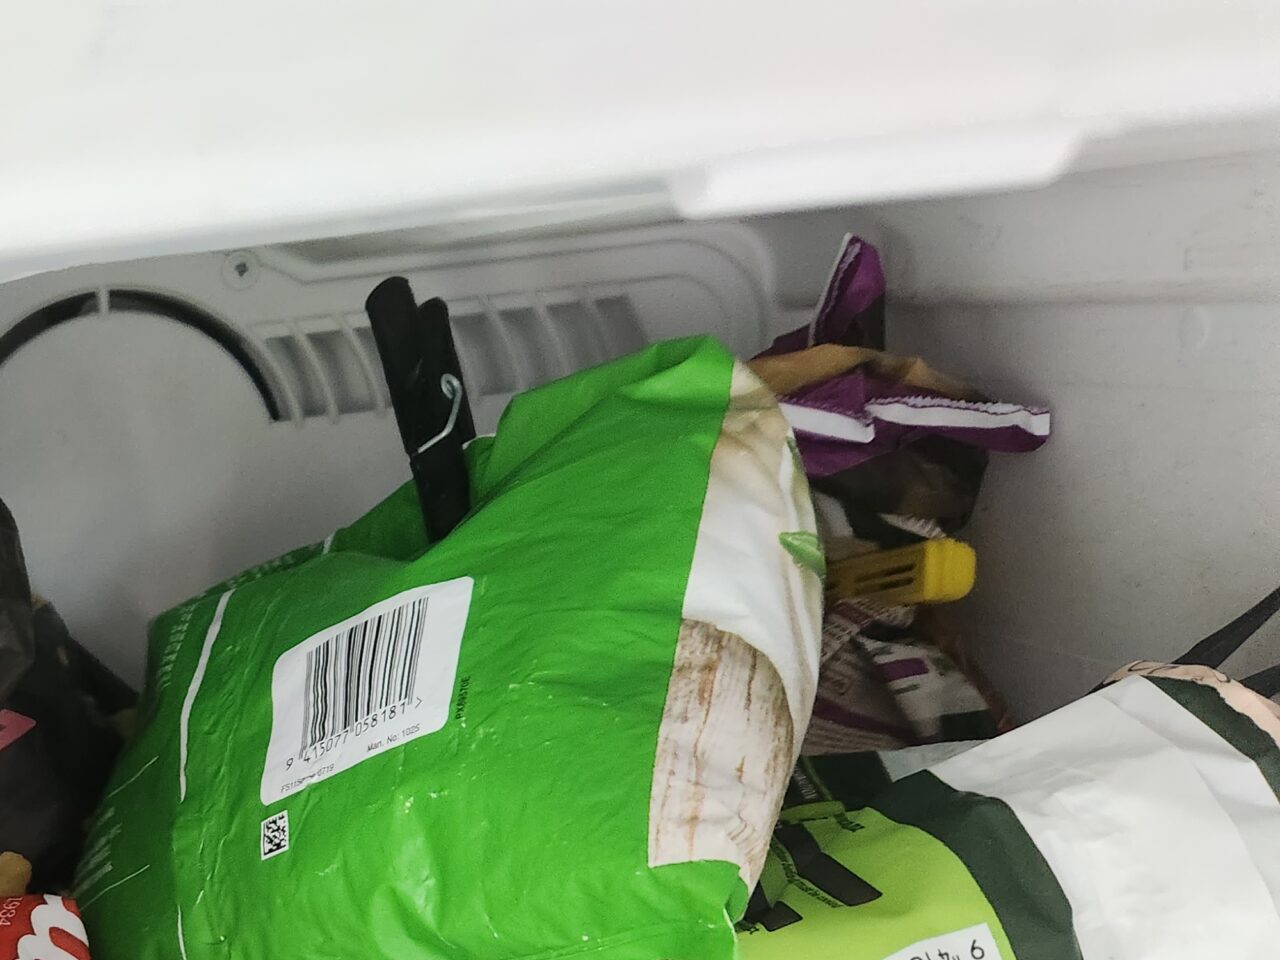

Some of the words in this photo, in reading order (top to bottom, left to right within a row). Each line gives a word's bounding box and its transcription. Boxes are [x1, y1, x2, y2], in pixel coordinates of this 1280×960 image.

[286, 757, 294, 771] 9
[303, 728, 349, 763] 415077
[355, 701, 406, 737] 058181
[970, 939, 985, 960] 9
